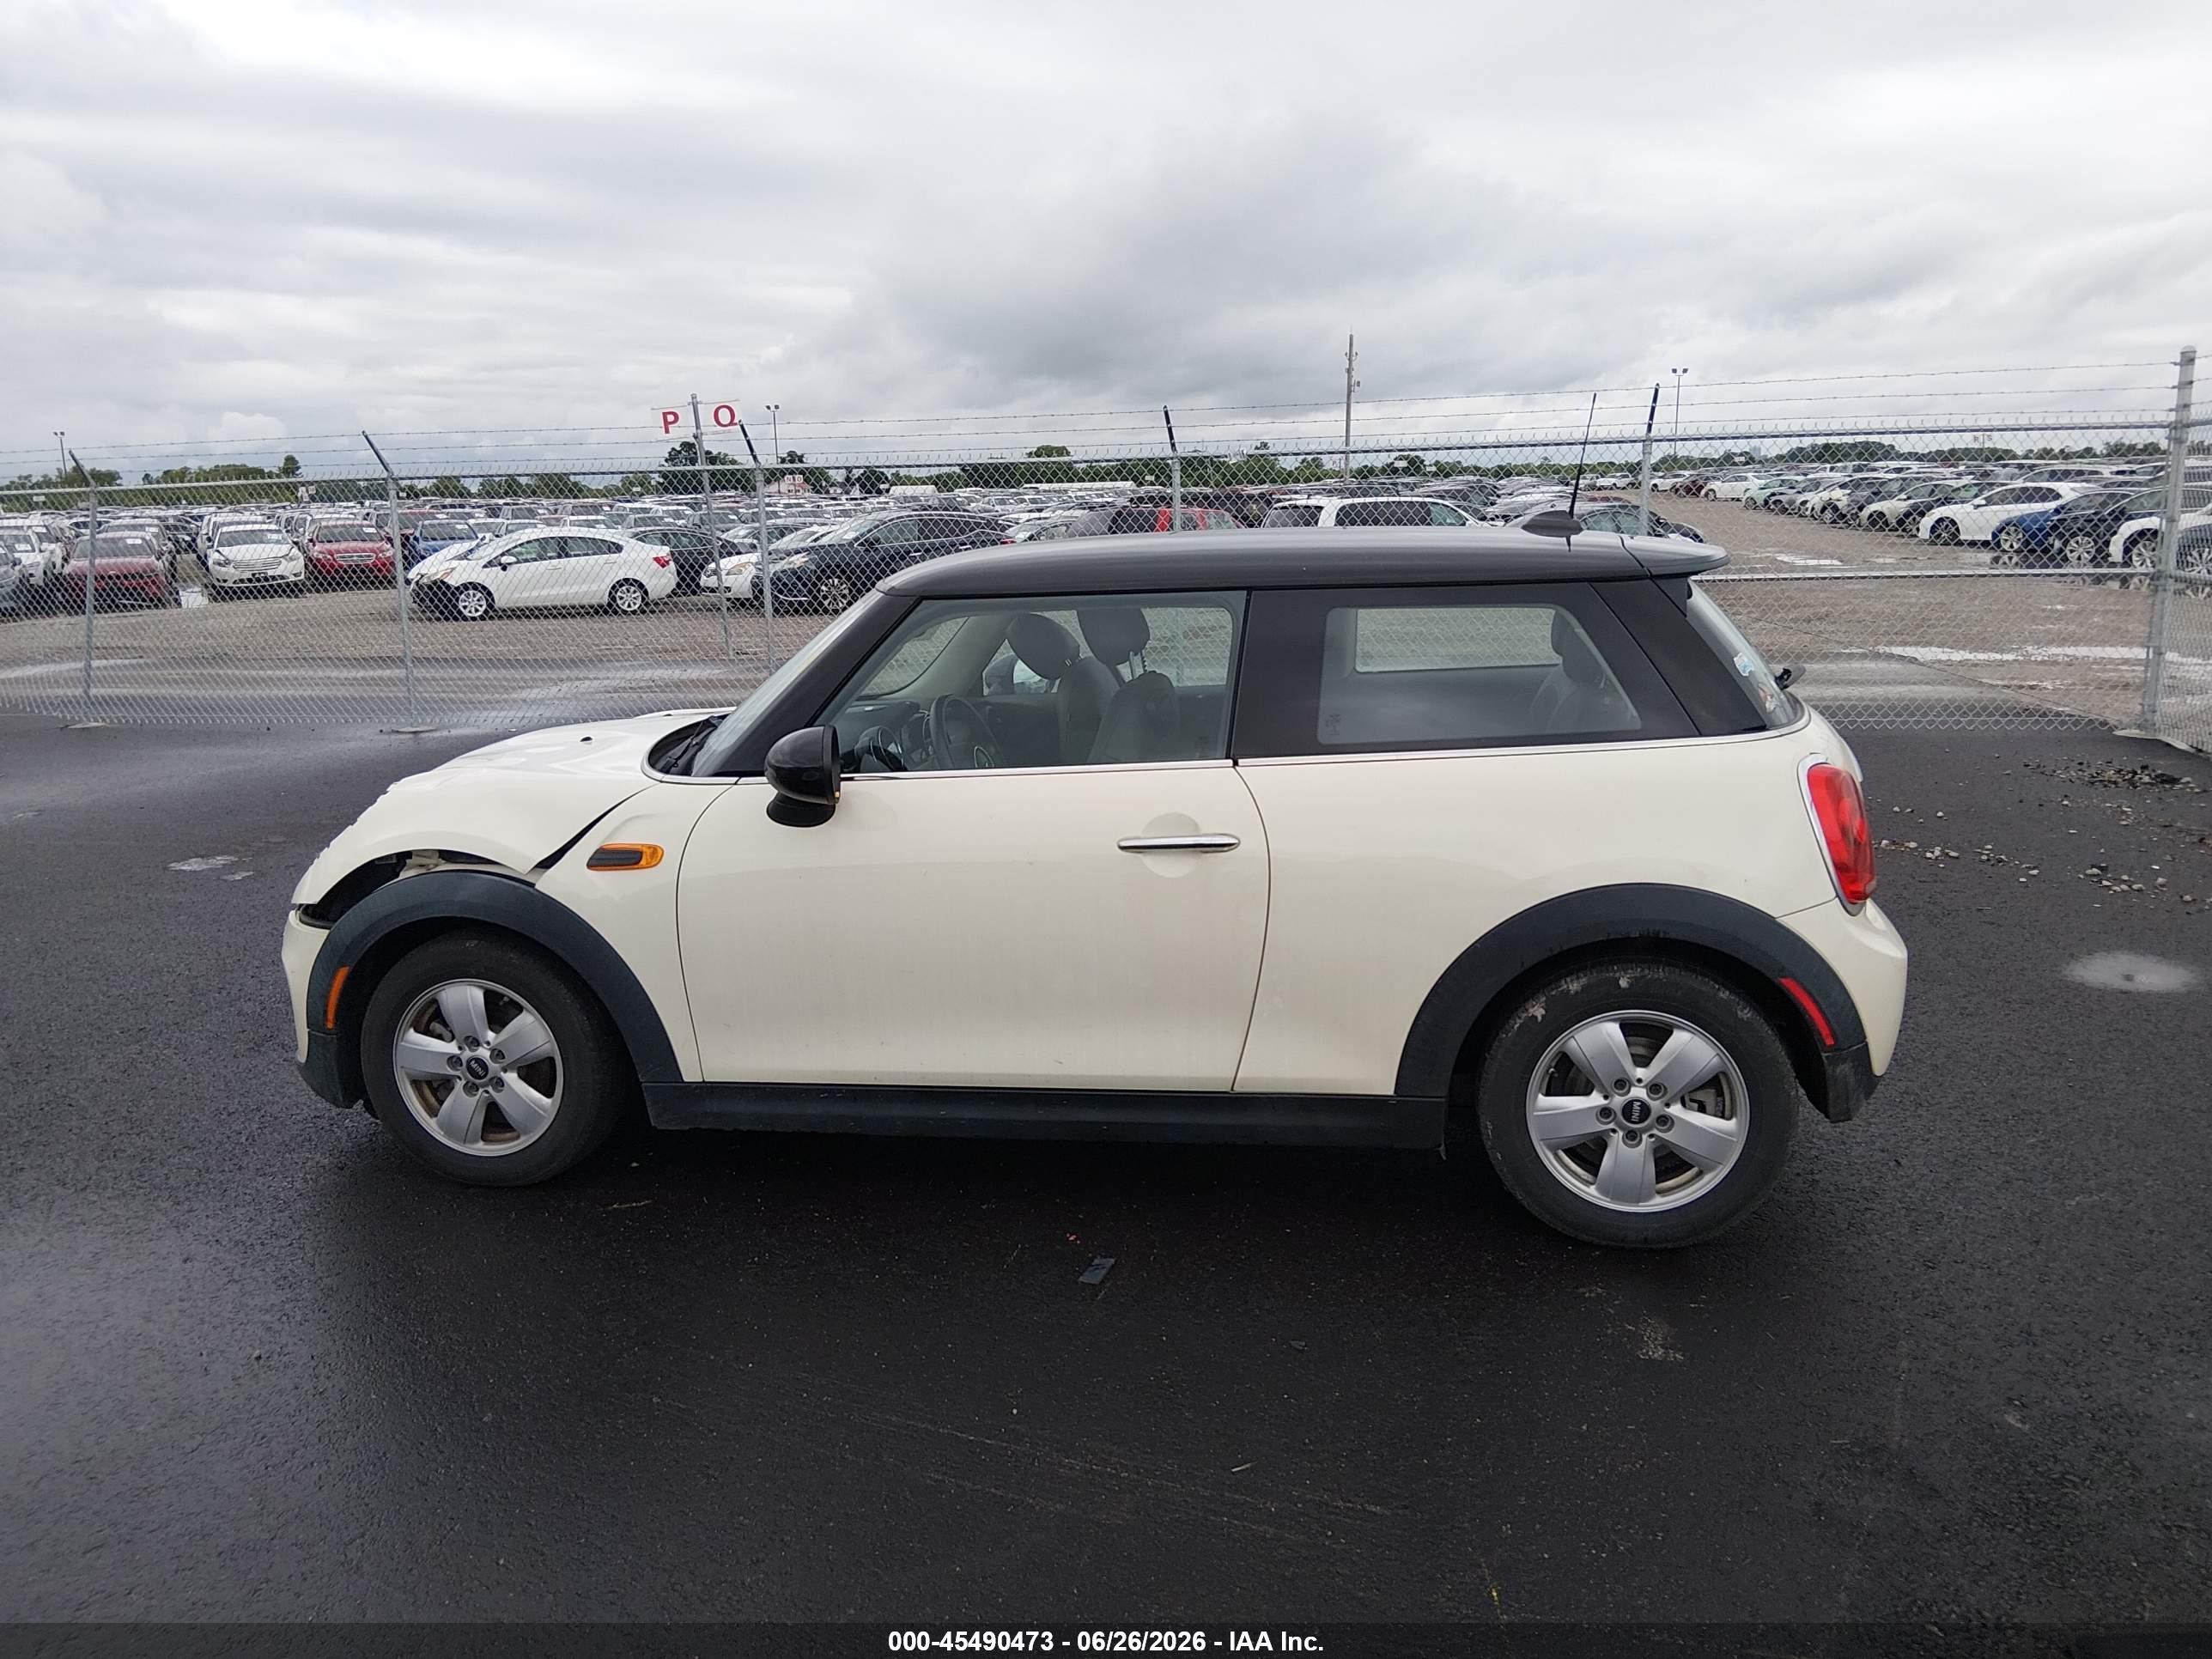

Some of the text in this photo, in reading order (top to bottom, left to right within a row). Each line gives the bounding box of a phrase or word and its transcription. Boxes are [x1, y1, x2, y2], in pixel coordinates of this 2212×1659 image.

[661, 404, 738, 434] P Q
[470, 1060, 486, 1077] MINI
[1631, 1101, 1642, 1122] MINI
